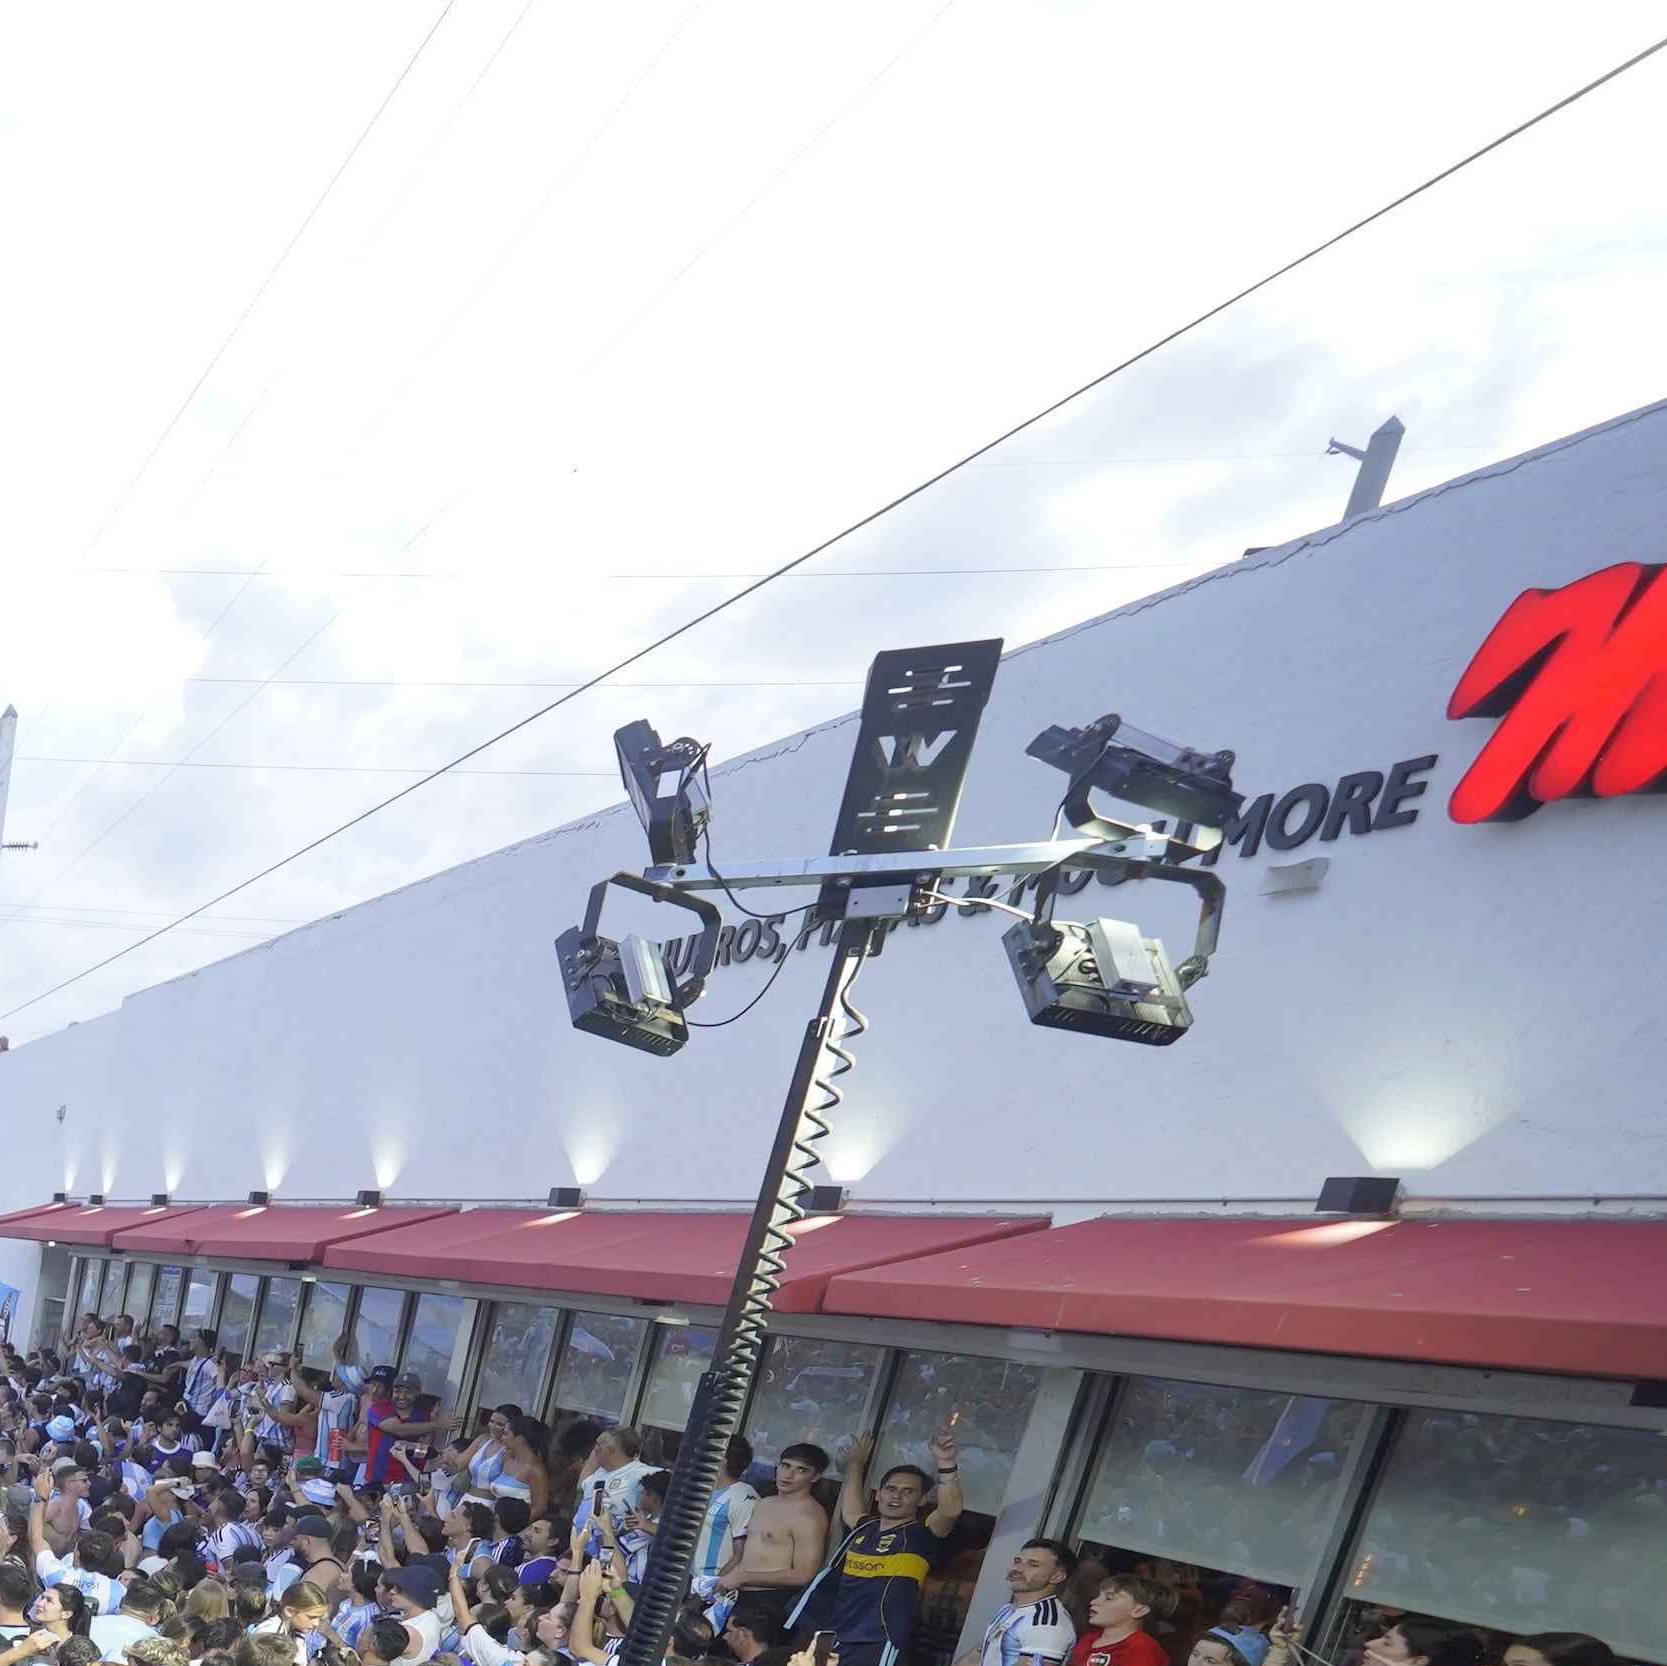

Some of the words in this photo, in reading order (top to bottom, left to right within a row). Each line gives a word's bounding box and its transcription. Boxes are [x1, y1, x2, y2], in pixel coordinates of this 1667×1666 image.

[657, 913, 787, 979] UROS,
[1200, 753, 1438, 867] MORE
[845, 1558, 885, 1571] tsson
